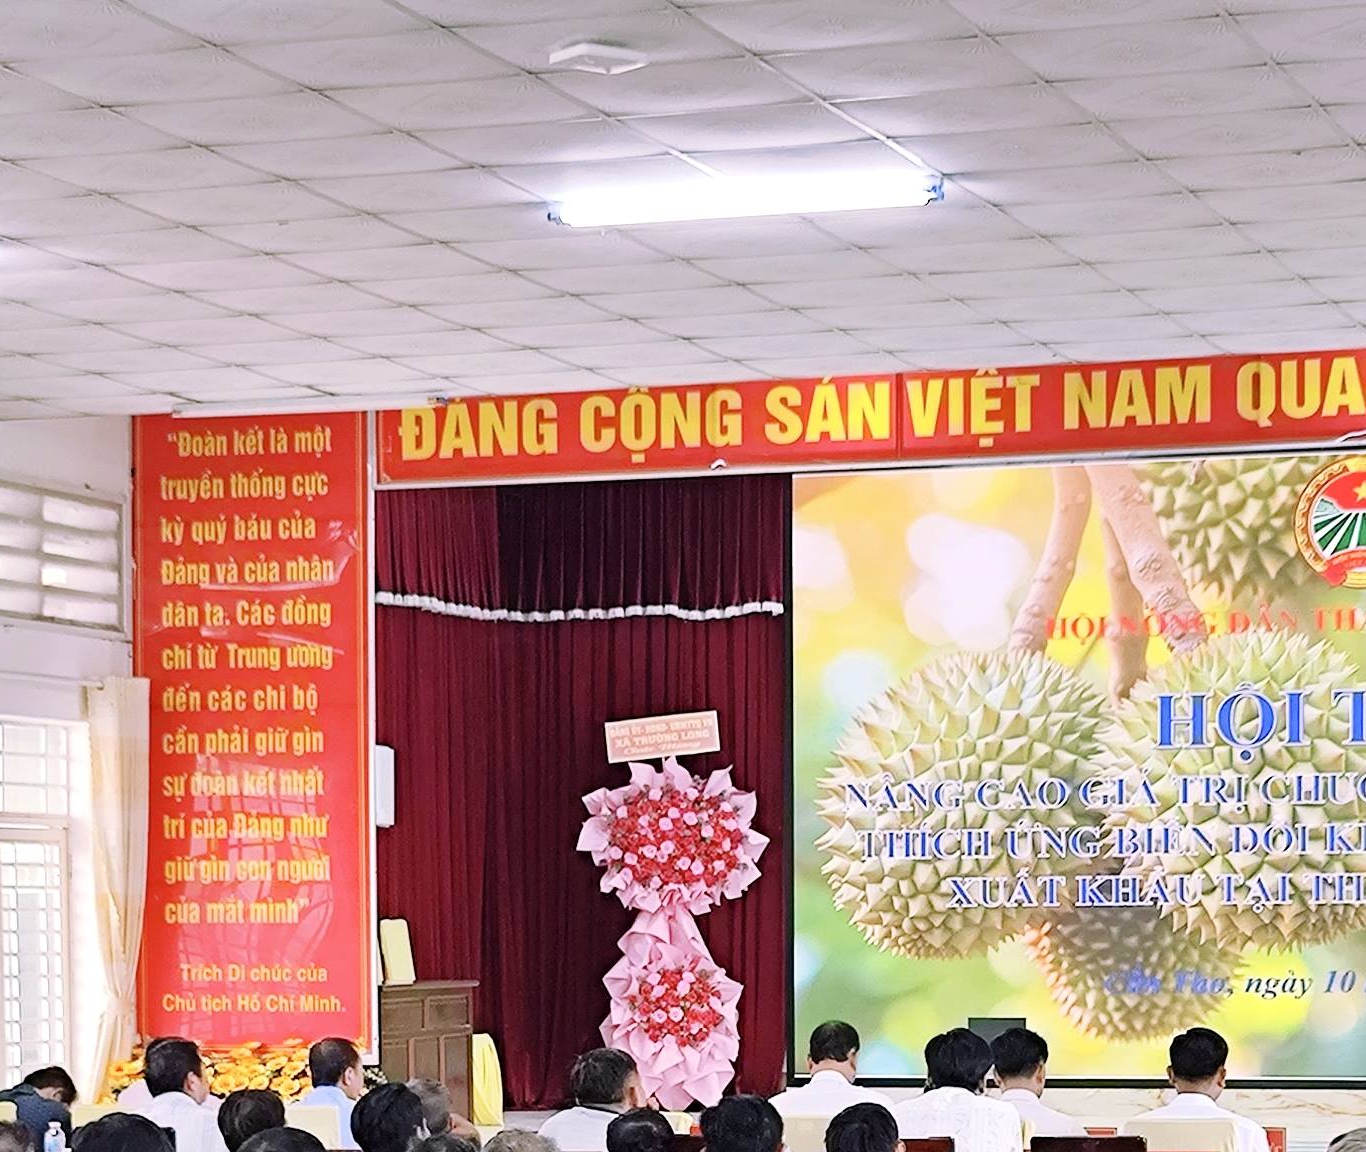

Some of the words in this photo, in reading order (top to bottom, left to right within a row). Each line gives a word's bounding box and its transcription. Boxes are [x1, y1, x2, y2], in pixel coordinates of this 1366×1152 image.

[579, 385, 742, 463] CỘNG
[905, 367, 1041, 448] VIỆT
[1064, 364, 1211, 430] NAM
[168, 429, 228, 457] “Đoàn
[234, 424, 264, 456] kết
[270, 426, 288, 455] là
[295, 425, 332, 458] một
[160, 471, 224, 502] truyền
[230, 467, 286, 500] thống
[292, 473, 329, 502] cực
[234, 513, 272, 541] báu
[278, 509, 316, 540] của
[161, 556, 210, 587] Đảng
[216, 557, 239, 583] và
[244, 553, 280, 583] của
[286, 559, 334, 584] nhân
[162, 600, 199, 628] dân
[205, 602, 231, 627] ta.
[236, 600, 276, 627] Các
[281, 595, 333, 629] đồng
[1227, 603, 1299, 635] DÂN
[163, 682, 202, 713] đến
[207, 685, 247, 712] các
[253, 684, 286, 712] chi
[293, 684, 318, 716] bộ
[1155, 683, 1311, 762] HỘI
[844, 773, 965, 813] NÂNG
[977, 774, 1069, 812] CAO
[1077, 769, 1161, 810] GIÁ
[1172, 771, 1248, 815] TRỊ
[857, 823, 993, 861] THÍCH
[1005, 818, 1101, 858] ỨNG
[1114, 815, 1221, 856] BIẾN
[949, 871, 1069, 910] XUẤT
[1076, 871, 1202, 909] KHẨU
[1216, 873, 1296, 914] TẠI
[180, 963, 223, 983] Trích
[228, 964, 246, 982] Di
[250, 960, 292, 983] chúc
[297, 961, 328, 983] của
[1245, 969, 1313, 1000] ngày
[1324, 969, 1356, 994] 10
[162, 991, 197, 1014] Chủ
[201, 994, 232, 1015] tịch
[237, 990, 263, 1014] Hồ
[265, 993, 296, 1014] Chí
